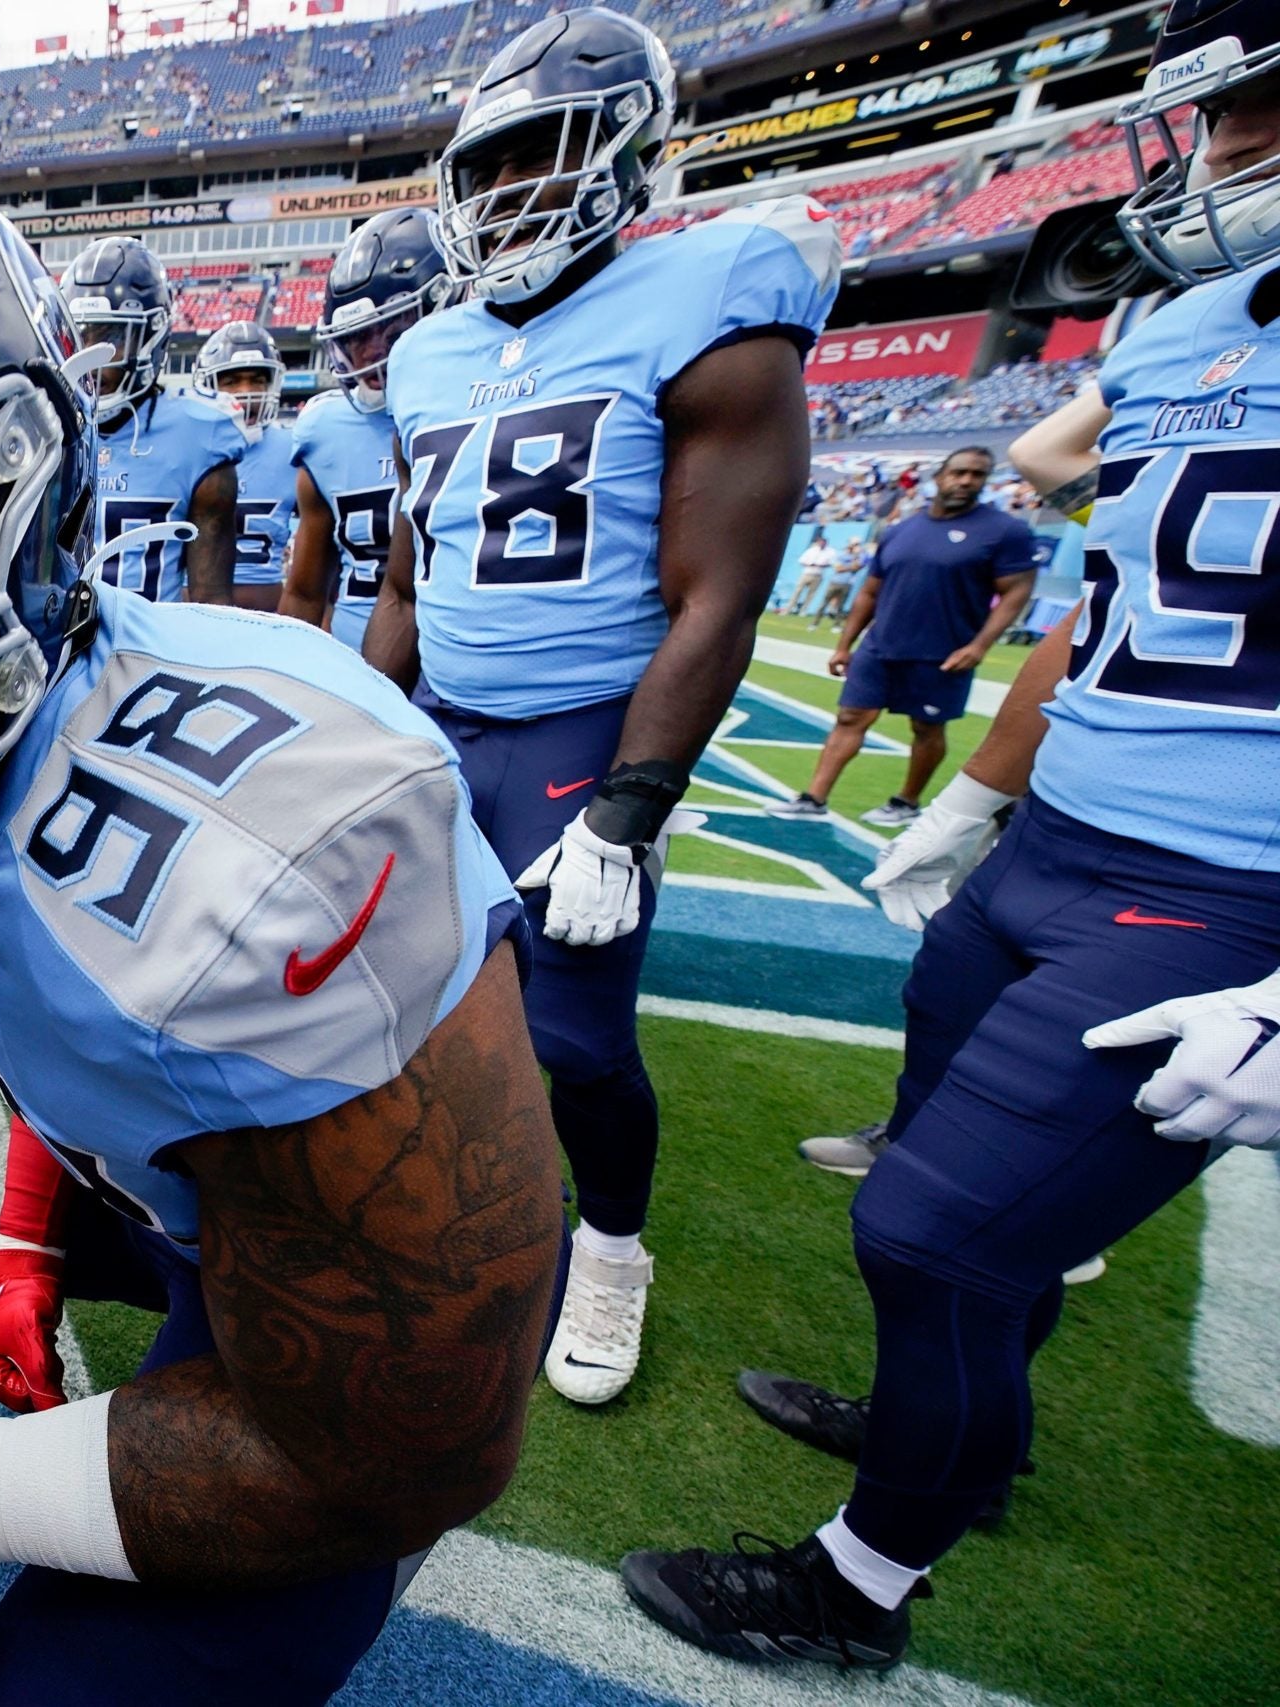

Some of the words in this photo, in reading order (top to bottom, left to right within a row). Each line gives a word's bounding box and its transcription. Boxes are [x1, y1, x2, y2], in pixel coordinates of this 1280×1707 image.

[1159, 52, 1206, 87] TITANS
[279, 191, 373, 214] UNLIMITED
[375, 184, 429, 205] MILES
[54, 208, 151, 232] CARWASHES
[805, 330, 952, 366] ISSAN
[467, 366, 543, 411] TITANS
[1147, 385, 1249, 441] TITANS
[410, 391, 623, 591] 78
[20, 665, 316, 944] 98
